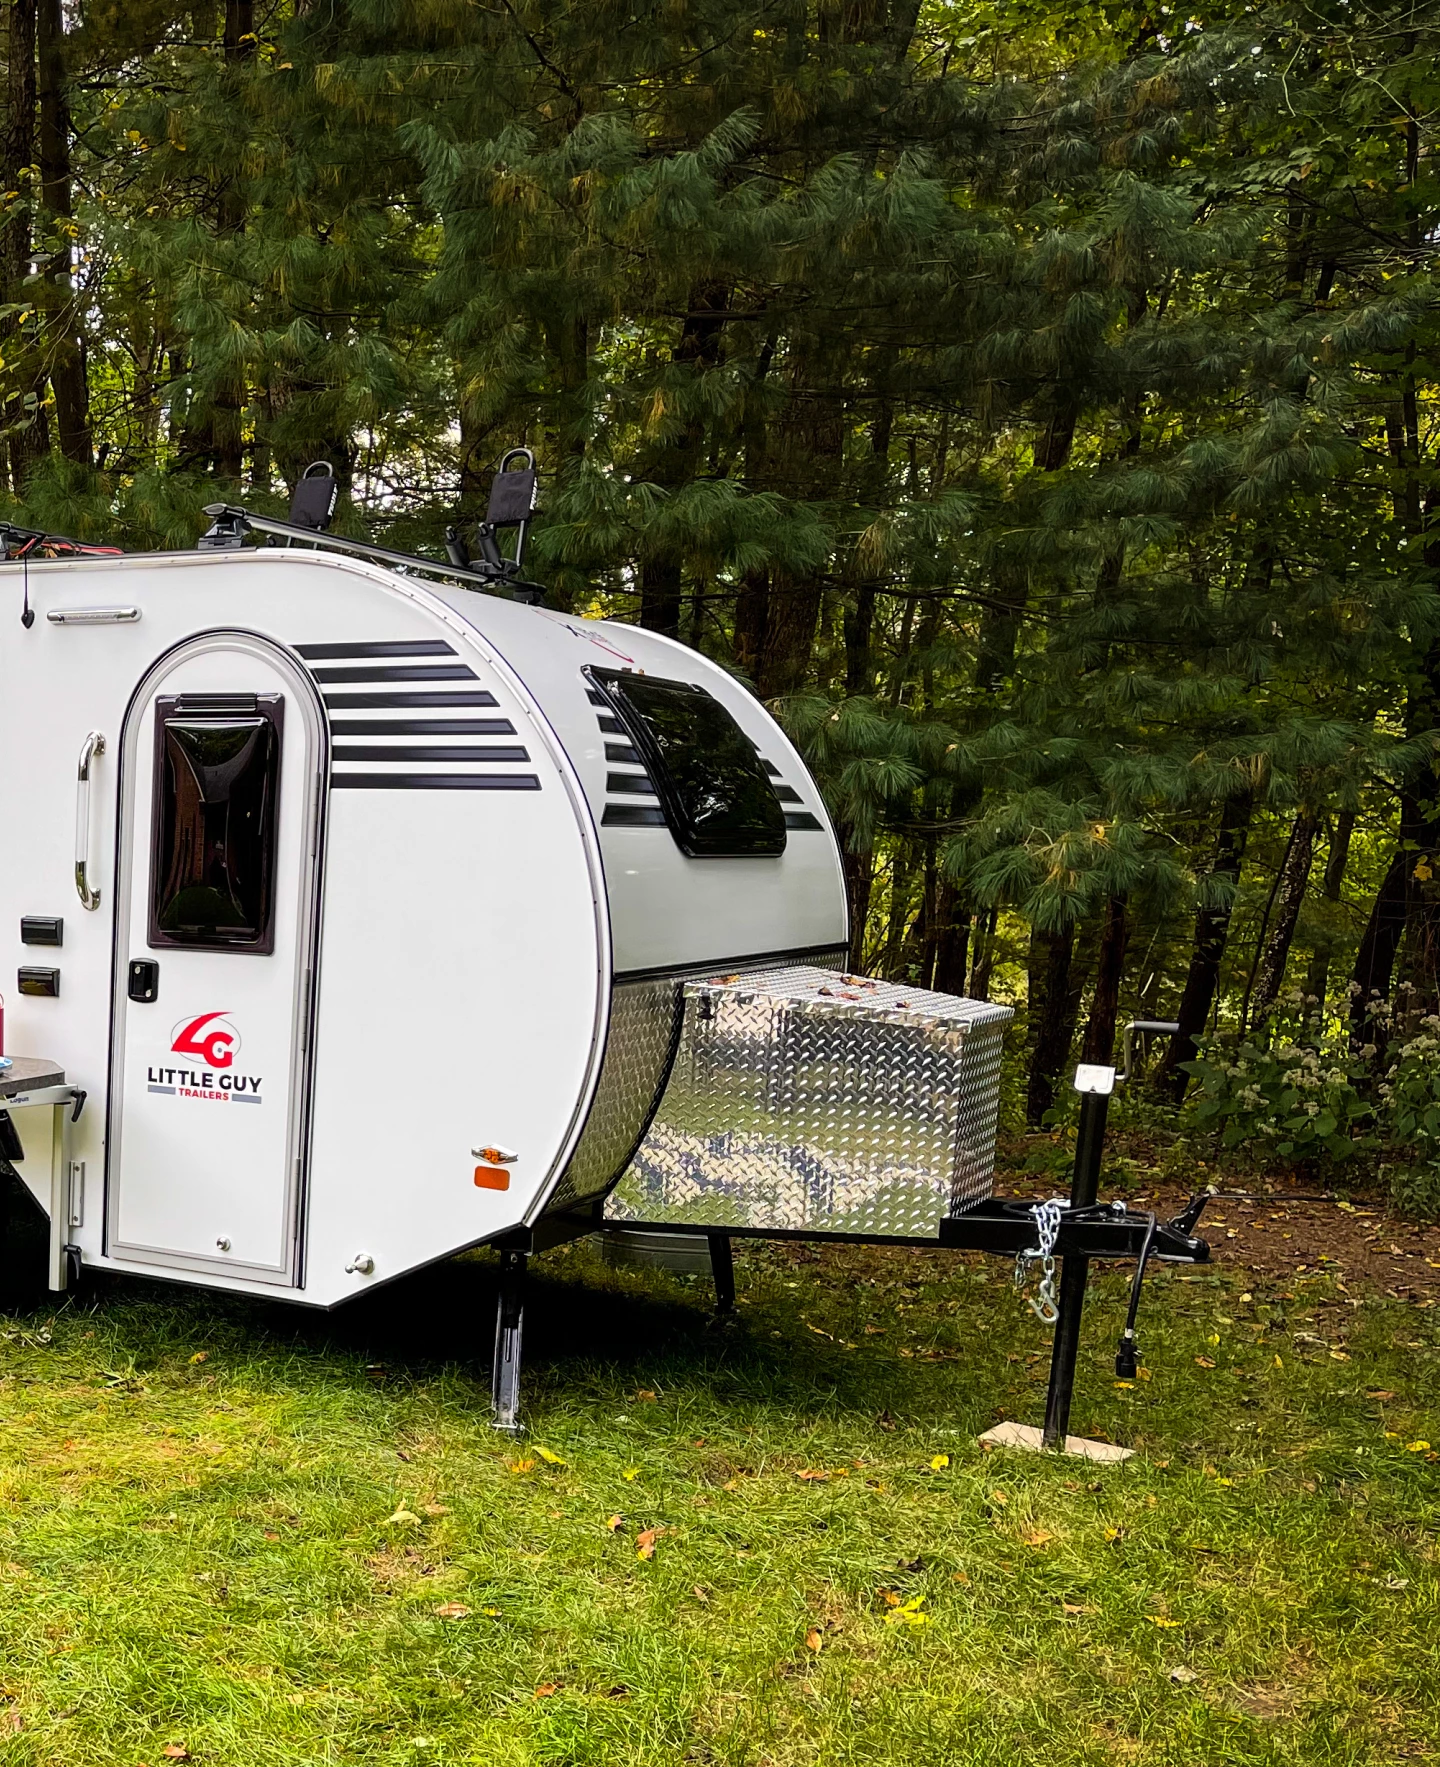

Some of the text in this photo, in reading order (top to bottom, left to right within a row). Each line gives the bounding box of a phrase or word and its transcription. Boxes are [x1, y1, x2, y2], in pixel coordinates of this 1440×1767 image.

[148, 1067, 263, 1093] LITTLE GUY
[178, 1087, 229, 1101] TRAILERS
